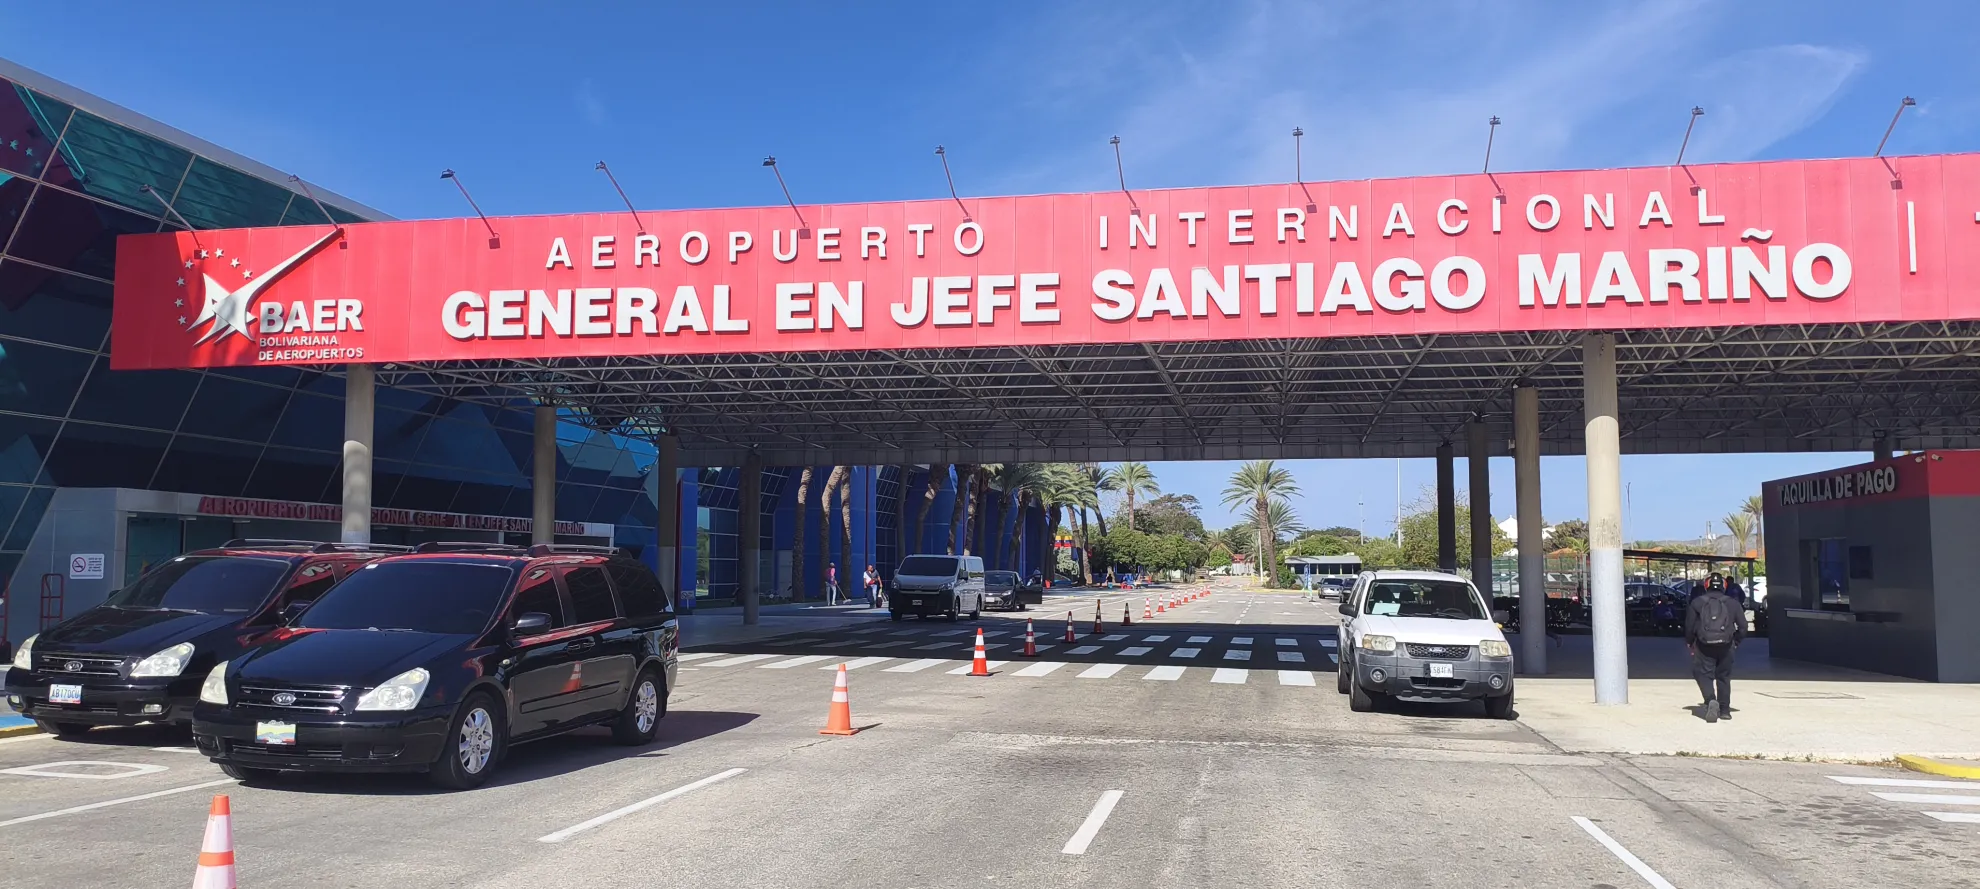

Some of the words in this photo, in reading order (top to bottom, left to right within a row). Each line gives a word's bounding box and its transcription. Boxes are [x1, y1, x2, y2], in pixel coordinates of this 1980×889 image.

[546, 221, 984, 268] AEROPUERTO
[1099, 188, 1726, 249] INTERNACIONAL
[441, 284, 750, 340] GENERAL
[775, 280, 864, 331] EN
[890, 272, 1061, 326] JEFE
[1090, 255, 1487, 320] SANTIAGO
[1517, 227, 1853, 306] MARIÑO
[260, 299, 363, 333] BAER
[259, 350, 273, 361] DE
[275, 347, 363, 360] AEROPUERTOS
[260, 335, 339, 347] BOLIVARIANA
[1778, 478, 1832, 506] TAQUILLA
[1835, 473, 1853, 499] DE
[1857, 466, 1895, 496] PAGO
[201, 497, 307, 519] AEROPUERTO
[309, 505, 413, 525] INTECIONAL
